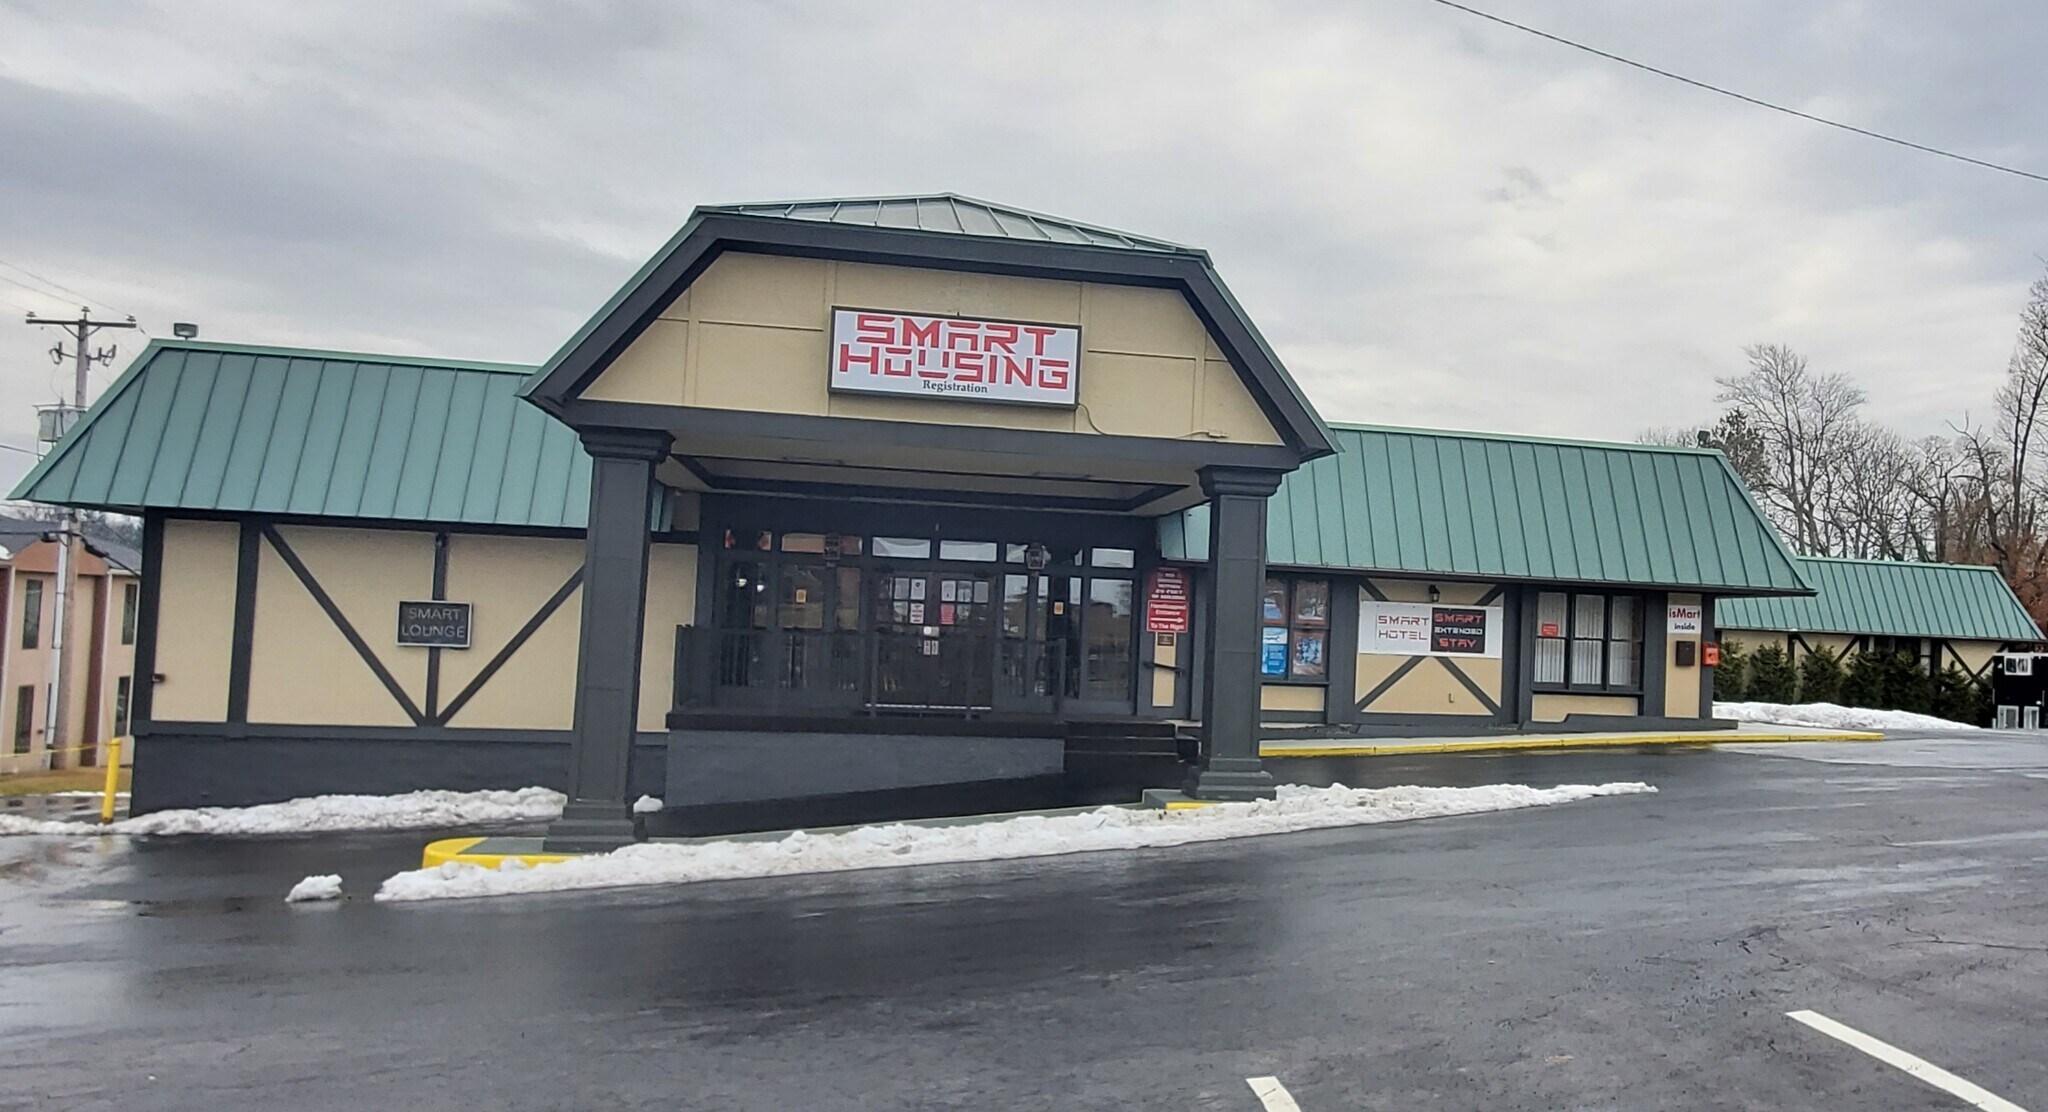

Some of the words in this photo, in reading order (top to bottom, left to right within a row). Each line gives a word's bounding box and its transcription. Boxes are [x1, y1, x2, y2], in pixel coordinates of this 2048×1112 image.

[856, 314, 1058, 357] SMART
[839, 343, 1070, 390] HOUSING
[922, 379, 988, 393] Registration
[409, 607, 461, 620] SMART
[1434, 613, 1483, 624] SMART
[1669, 607, 1700, 619] isMart
[1378, 615, 1430, 626] SMART
[1674, 622, 1696, 630] inside
[401, 624, 466, 638] LOUNGE
[1378, 630, 1428, 640] HOTEL
[1434, 626, 1483, 635] EXTENDED
[1439, 638, 1477, 648] STAY
